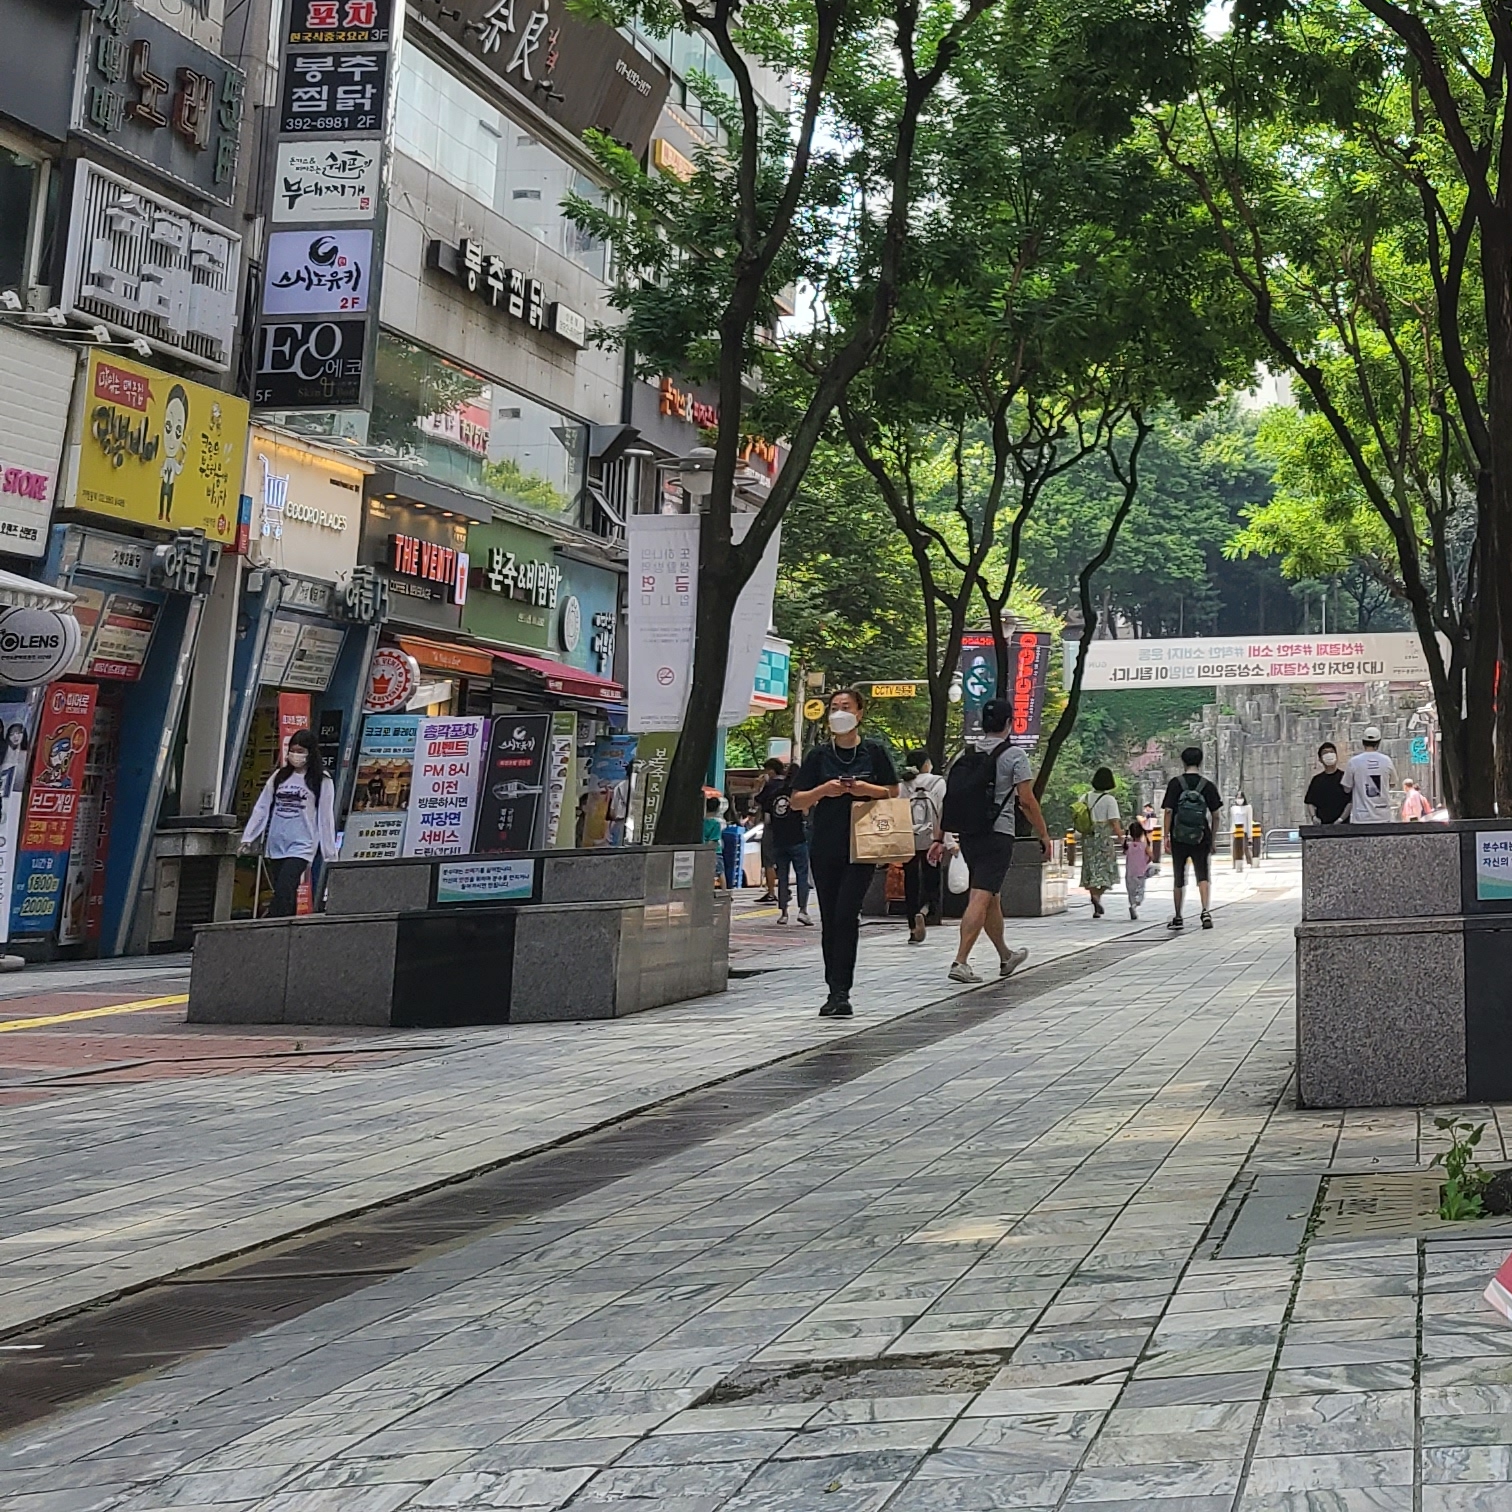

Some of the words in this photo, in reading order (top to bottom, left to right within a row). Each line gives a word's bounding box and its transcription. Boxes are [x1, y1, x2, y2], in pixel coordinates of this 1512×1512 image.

[305, 0, 378, 29] 포차
[370, 29, 389, 42] 3F
[293, 54, 379, 83] 봉추
[125, 39, 217, 152] 노래
[291, 83, 378, 112] 찜닭
[285, 117, 349, 131] 392-6981
[356, 114, 376, 129] 2F
[281, 176, 366, 210] 부대찌개
[463, 238, 547, 331] 봉추찜닭
[339, 296, 361, 311] 2F
[258, 321, 343, 381] ECO
[325, 357, 363, 379] 에코
[254, 388, 273, 402] 5F
[3, 466, 49, 502] STORE
[319, 509, 348, 532] PLACES
[393, 533, 420, 576] THE
[421, 540, 457, 586] VENTI
[487, 546, 563, 610] 본죽&비빔밥
[874, 686, 895, 696] CCTV
[423, 722, 479, 741] 총각포차
[427, 740, 469, 757] 이벤트
[423, 763, 445, 777] PM
[447, 761, 470, 777] 8시
[431, 780, 459, 796] 이전
[29, 792, 76, 815] 보드게임
[418, 796, 468, 809] 방문하시면
[420, 811, 461, 827] 짜장면
[418, 829, 459, 844] 서비스
[1482, 856, 1509, 868] 자신의
